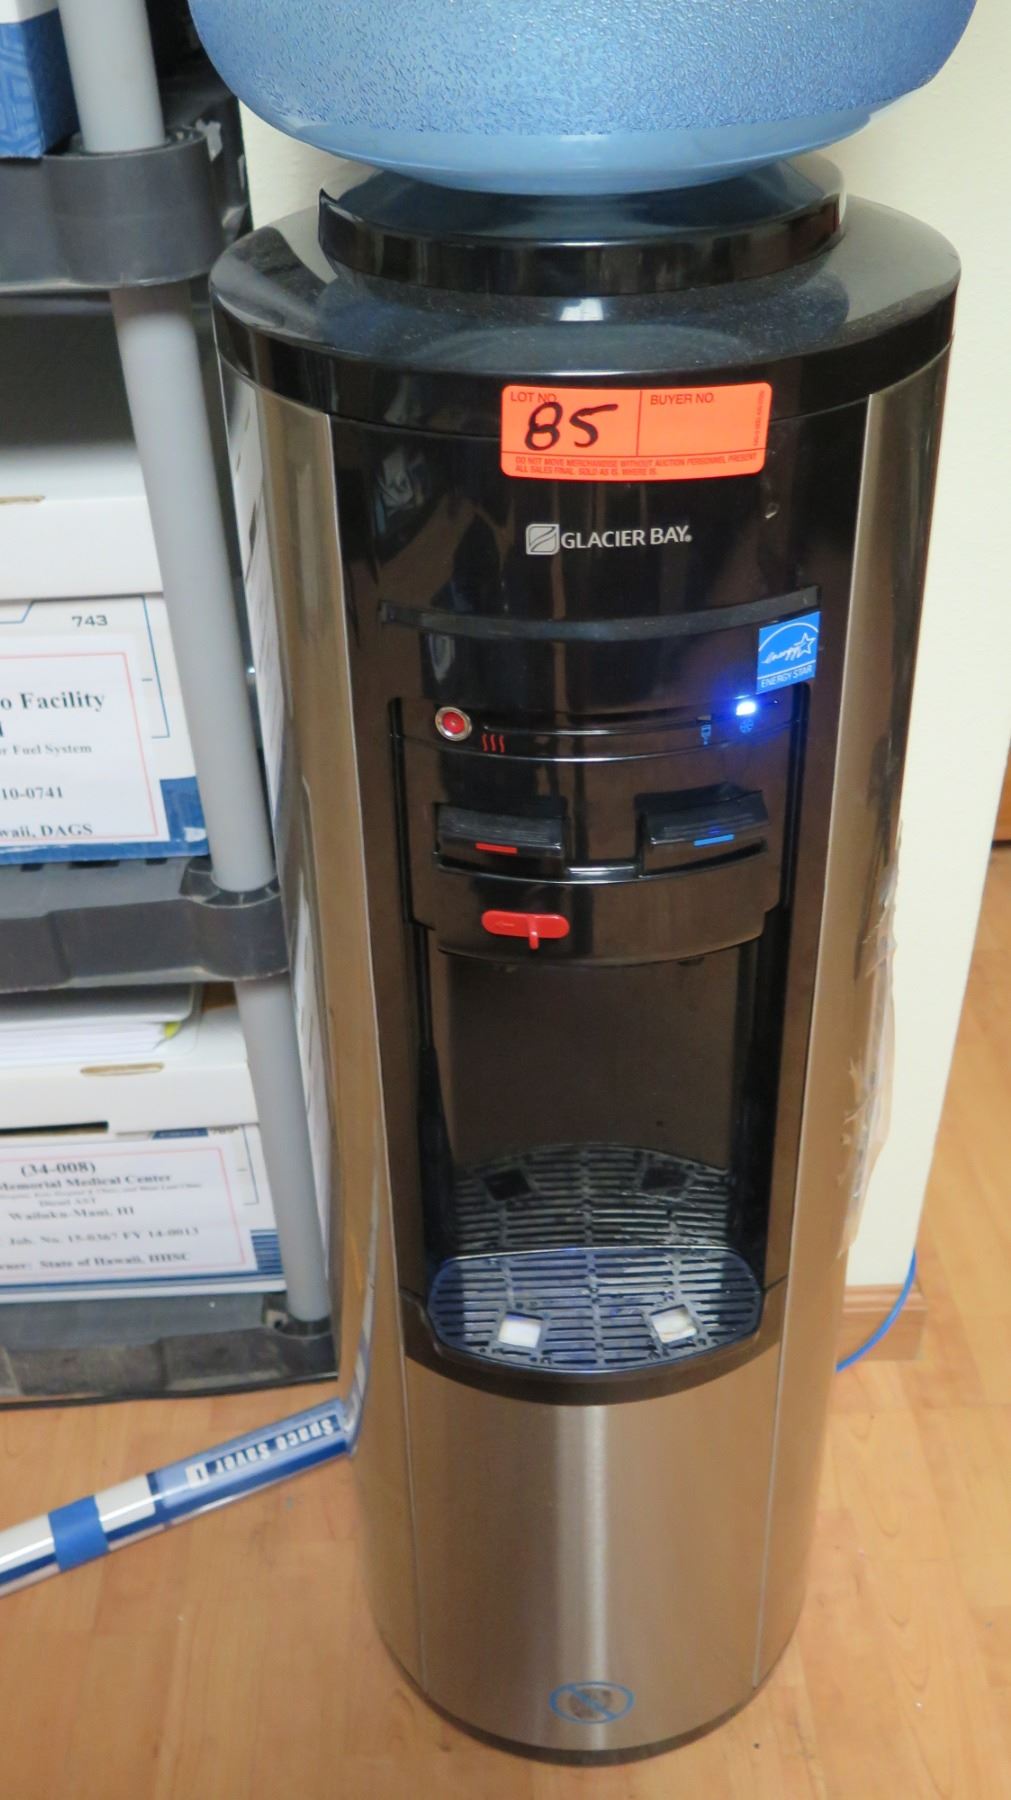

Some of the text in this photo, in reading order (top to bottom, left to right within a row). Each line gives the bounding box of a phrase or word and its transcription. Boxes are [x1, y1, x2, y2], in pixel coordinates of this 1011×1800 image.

[510, 391, 535, 403] LOT
[650, 394, 692, 406] BUYER
[524, 401, 619, 451] 85
[560, 530, 646, 549] GLACIER
[71, 614, 108, 627] 743
[760, 664, 813, 688] ENERGY STAR
[20, 690, 106, 712] Facility
[12, 744, 41, 756] Fuel
[45, 742, 92, 757] System
[41, 823, 94, 837] DAGS
[20, 1161, 96, 1177] (34-008)
[66, 1176, 122, 1187] Medical
[124, 1173, 172, 1184] Center
[40, 1260, 73, 1268] State
[77, 1257, 90, 1266] of
[214, 1418, 333, 1474] Space Saver
